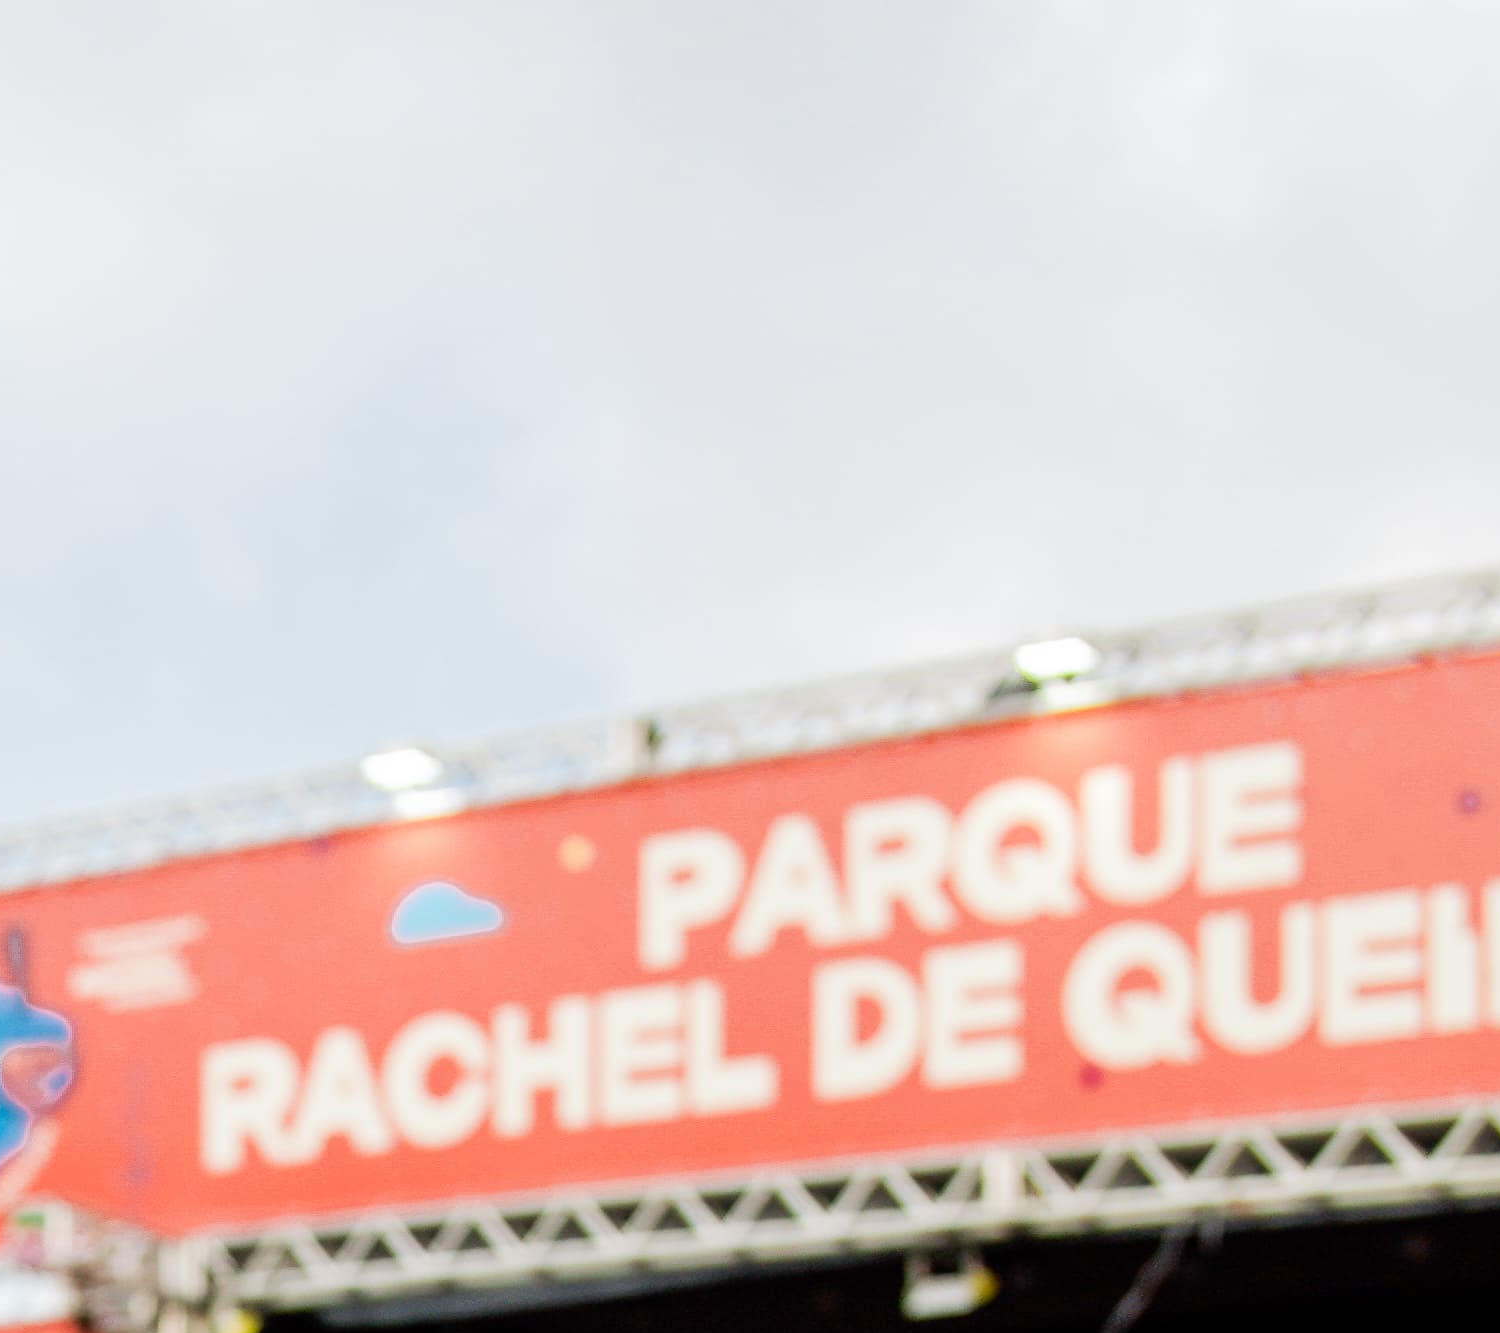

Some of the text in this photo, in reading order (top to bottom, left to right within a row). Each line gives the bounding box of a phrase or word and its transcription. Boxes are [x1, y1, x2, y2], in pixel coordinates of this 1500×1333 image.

[636, 742, 1304, 970] PARQUE
[200, 978, 780, 1176] RACHEL
[812, 940, 1026, 1102] DE
